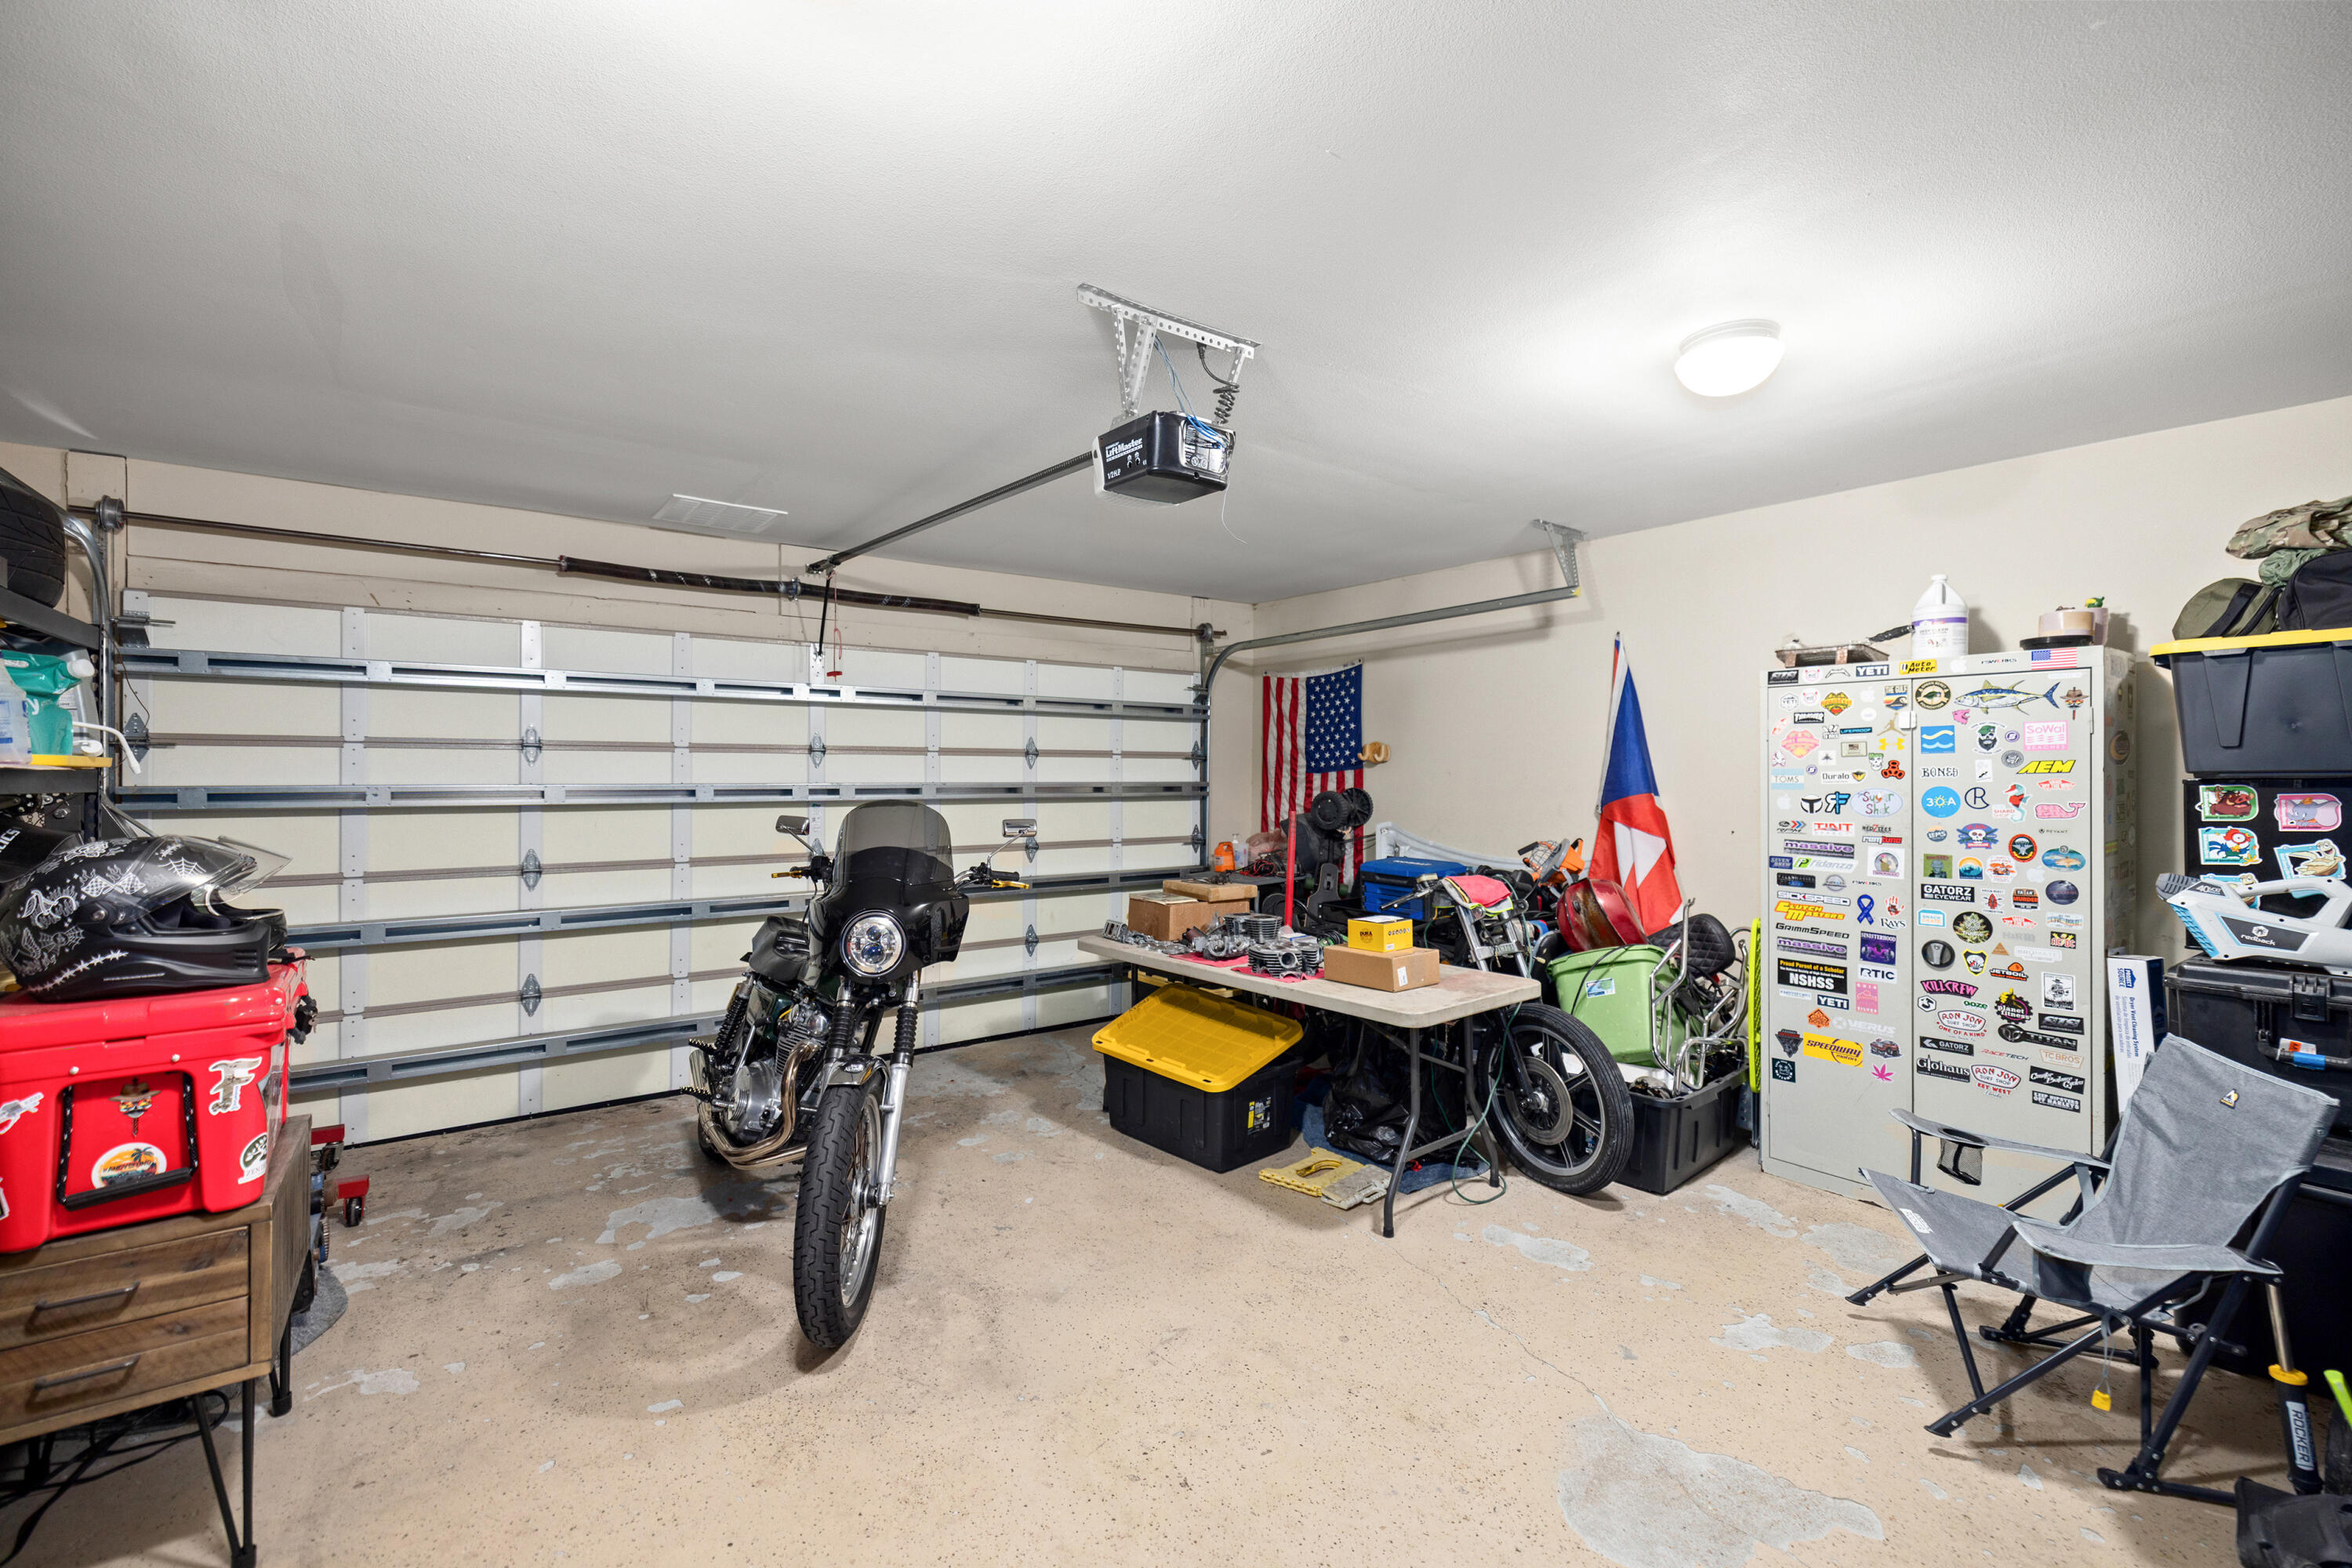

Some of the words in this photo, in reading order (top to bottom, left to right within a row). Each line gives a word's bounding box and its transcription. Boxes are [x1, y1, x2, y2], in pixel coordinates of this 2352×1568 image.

[1105, 437, 1142, 459] LiftMaster
[1857, 666, 1888, 676] YETI
[2027, 722, 2065, 734] SoWal
[2016, 760, 2076, 775] AEM
[1814, 822, 1853, 832] TINT
[1785, 841, 1854, 853] massive
[1924, 885, 1972, 896] GATORZ
[2196, 884, 2209, 894] 40
[2241, 933, 2276, 946] redback
[1778, 938, 1846, 954] massive
[1860, 967, 1895, 980] RTIC
[1990, 968, 2027, 978] JETBOIL
[1789, 972, 1835, 990] NSHSS
[1819, 996, 1848, 1009] YETI
[1997, 1004, 2025, 1014] planet
[1963, 1015, 1982, 1025] JON
[1939, 1040, 1969, 1051] GATORZ
[2030, 1033, 2076, 1047] TITAN
[1807, 1040, 1861, 1058] SPEEDWAY
[2056, 1052, 2081, 1064] BROS
[1917, 1055, 1969, 1076] Glohaus
[1997, 1071, 2017, 1082] JON
[2292, 1409, 2310, 1463] ROCKER
